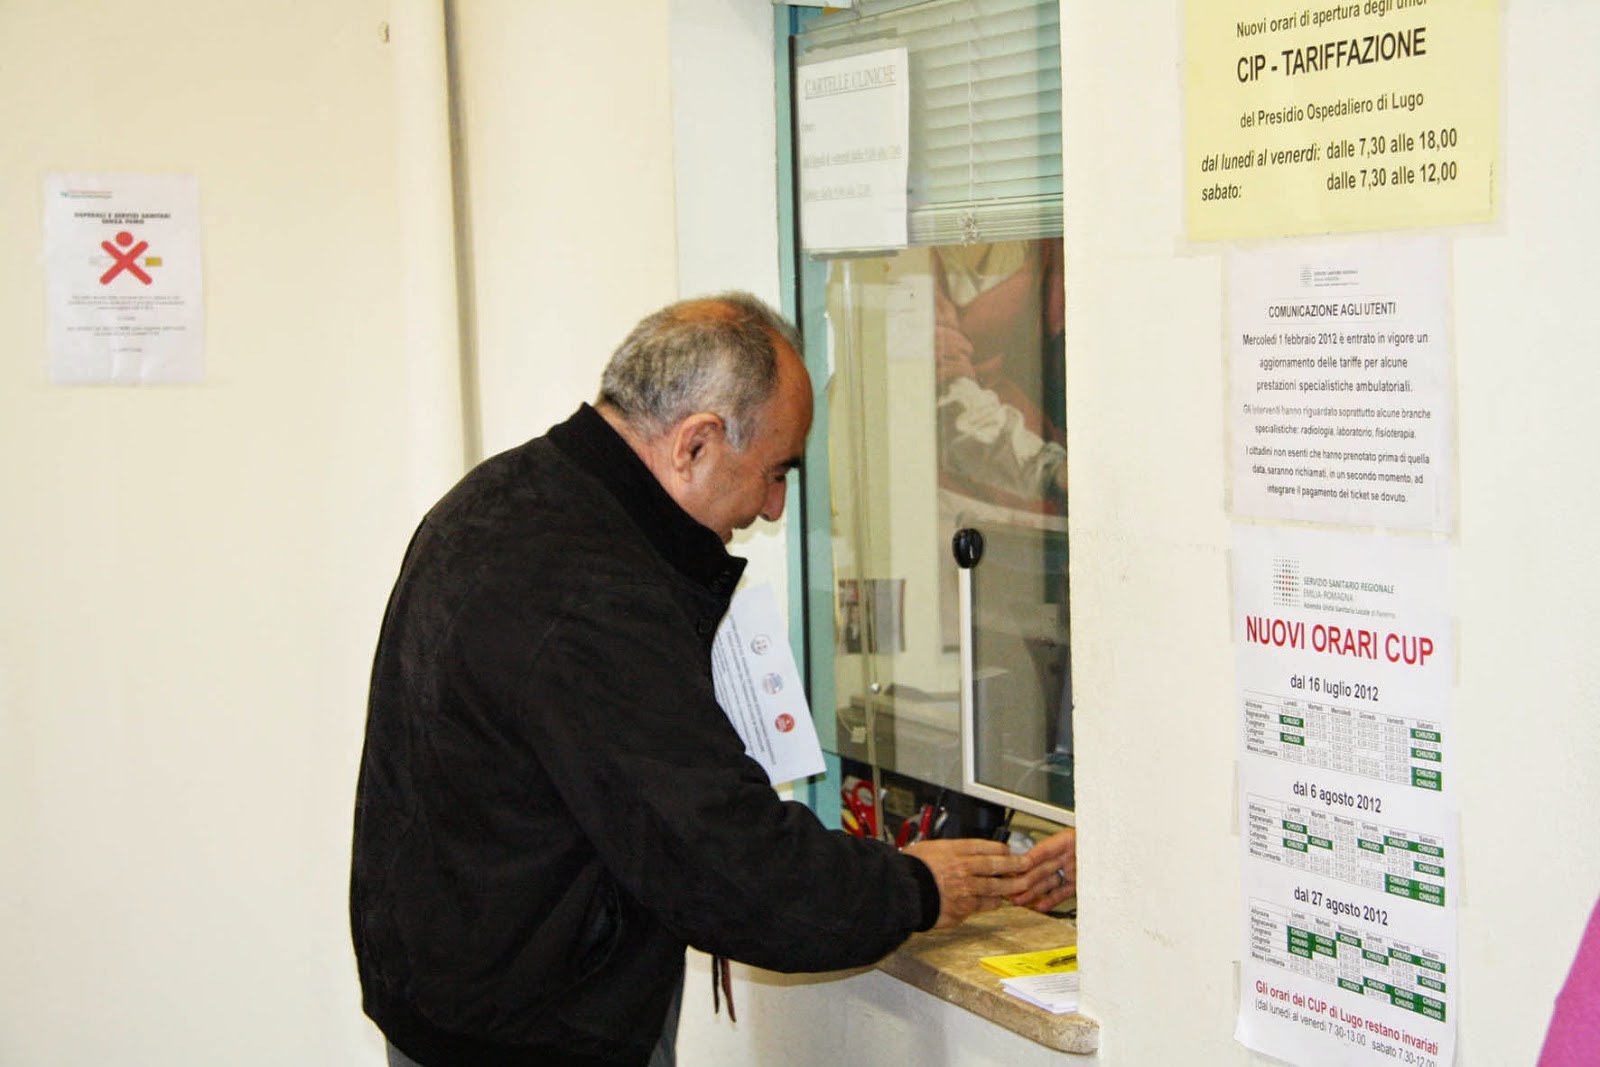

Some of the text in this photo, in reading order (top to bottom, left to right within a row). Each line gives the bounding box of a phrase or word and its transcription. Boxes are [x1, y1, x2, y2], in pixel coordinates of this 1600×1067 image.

[1237, 17, 1266, 38] Nuovi
[1270, 12, 1296, 32] orari
[1300, 10, 1309, 27] di
[1313, 4, 1359, 24] apertura
[1364, 0, 1391, 15] degli
[1238, 54, 1265, 83] CIP
[1282, 27, 1426, 76] TARIFFAZIONE
[1241, 93, 1424, 128] del Presidio Ospedaliero di Lugo
[1201, 128, 1457, 172] dal lunedì al venerdì: dalle 7,30 alle 18,00
[1202, 161, 1457, 201] sabato: dalle 7,30 alle 12,00
[1269, 302, 1396, 318] COMUNICAZIONE AGLI UTENTI
[1279, 334, 1282, 345] 1
[1285, 334, 1316, 345] febbraio
[1319, 333, 1337, 344] 2012
[1340, 332, 1344, 344] è
[1347, 333, 1375, 344] entrato
[1378, 332, 1385, 343] in
[1388, 332, 1414, 346] vigore
[1417, 334, 1428, 343] un
[1260, 356, 1407, 371] aggiornamento delle tariffe per alcune
[1257, 379, 1296, 392] prestazioni
[1299, 380, 1353, 393] specialistiche
[1243, 404, 1251, 414] Gli
[1282, 405, 1301, 417] hanno
[1304, 406, 1337, 418] riguardato
[1339, 408, 1375, 419] soprattutto
[1377, 408, 1400, 418] alcune
[1402, 408, 1430, 419] branche
[1246, 445, 1429, 464] I cittadini non esenti che hanno prenotato prima di quella
[1268, 467, 1293, 476] saranno
[1330, 469, 1335, 478] in
[1347, 471, 1376, 481] secondo
[1415, 474, 1423, 484] ad
[1267, 485, 1295, 496] integrare
[1297, 485, 1300, 494] il
[1302, 488, 1337, 498] pagamento
[1340, 489, 1349, 498] del
[1351, 490, 1369, 500] ticket
[1372, 492, 1379, 501] se
[1246, 616, 1433, 666] NUOVI ORARI CUP
[1291, 674, 1379, 701] dal 16 luglio 2012
[1283, 717, 1299, 725] CHIUSO
[1415, 731, 1435, 739] CHIUSO
[1416, 750, 1436, 759] CHIUSO
[1416, 769, 1436, 778] CHIUSO
[1416, 779, 1436, 788] CHIUSO
[1293, 781, 1381, 813] dal 6 agosto 2012
[1312, 838, 1328, 847] CHIUSO
[1362, 841, 1380, 851] CHIUSO
[1389, 838, 1438, 854] CHIUSO CHIUSO
[1419, 864, 1439, 874] CHIUSO
[1390, 876, 1439, 894] CHIUSO CHIUSO
[1390, 885, 1439, 903] CHIUSO CHIUSO
[1294, 887, 1388, 925] dal 27 agosto 2012
[1366, 951, 1384, 962] CHIUSO
[1393, 950, 1440, 970] CHIUSO CHIUSO
[1422, 978, 1440, 989] CHIUSO
[1368, 980, 1441, 1008] CHIUSO CHIUSO CHIUSO
[1395, 998, 1441, 1019] CHIUSO CHIUSO
[1256, 980, 1438, 1055] Gli orari del CUP di Lugo restano invariati
[1293, 1011, 1298, 1021] al
[1372, 1040, 1396, 1057] sabato
